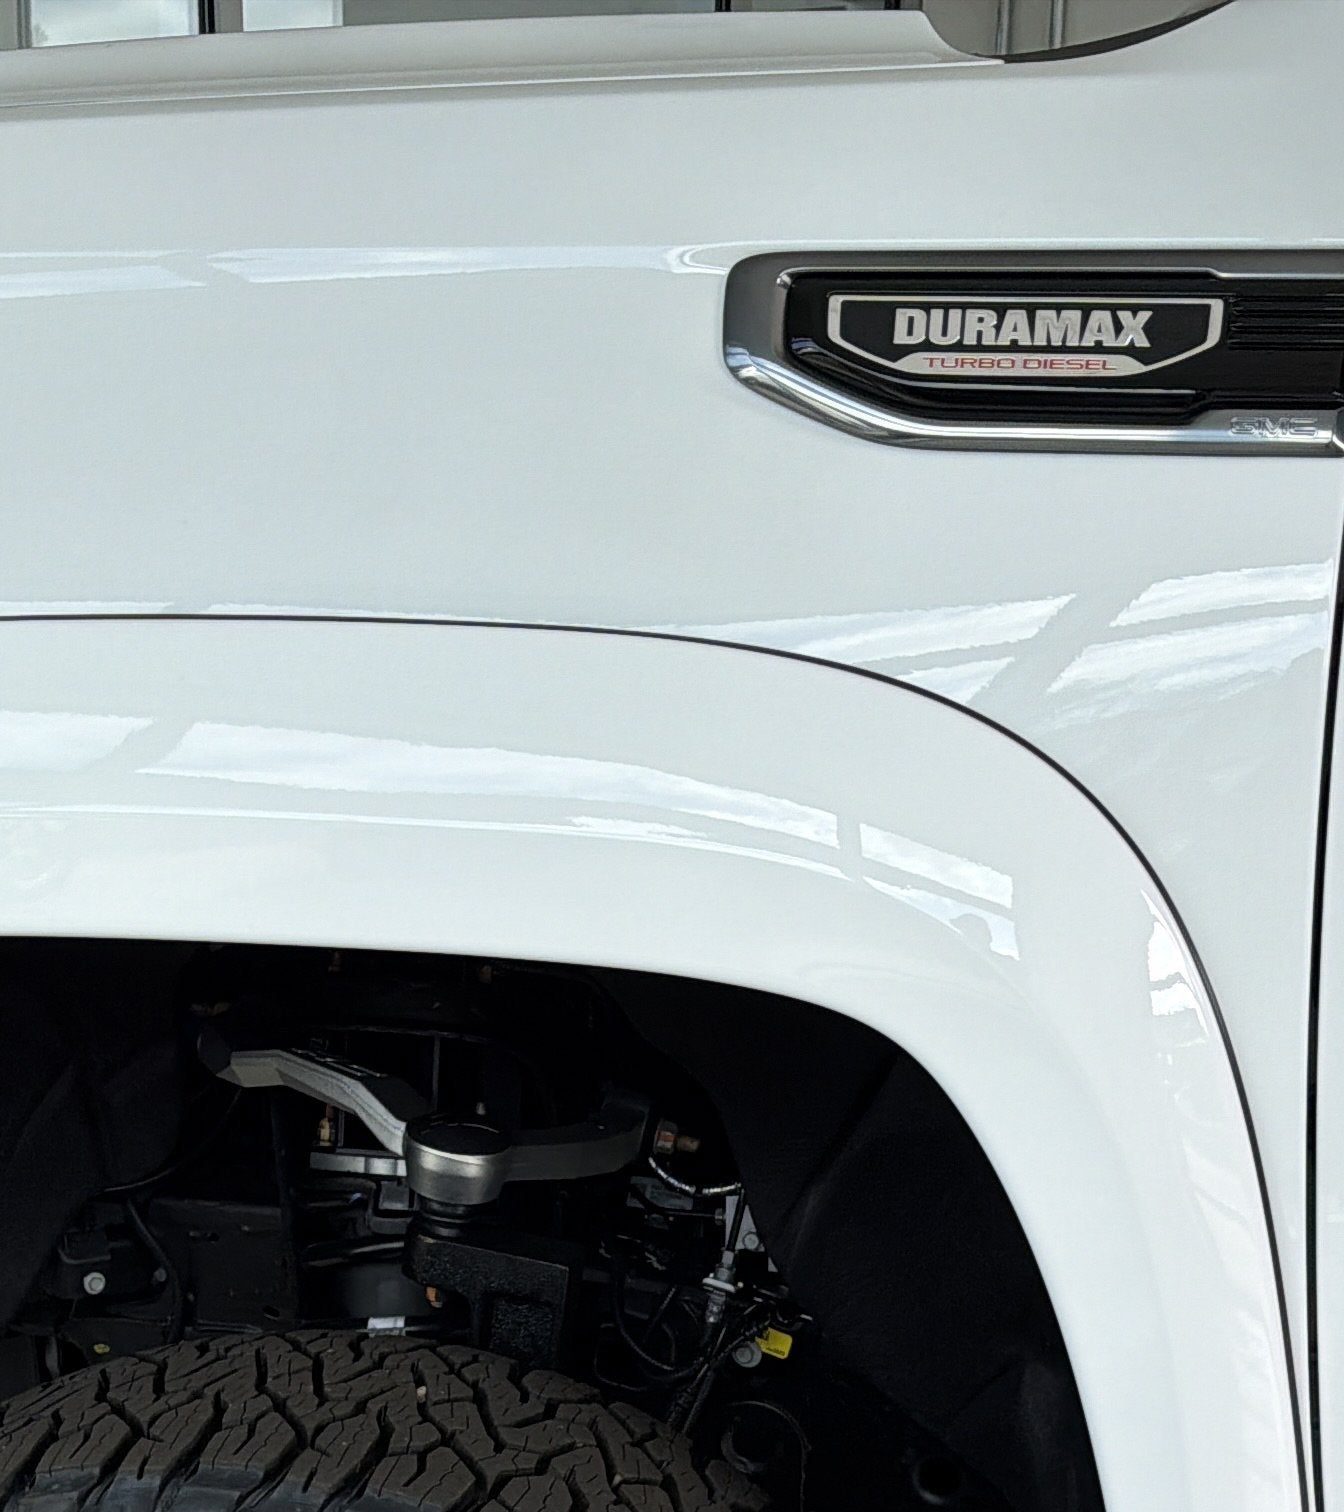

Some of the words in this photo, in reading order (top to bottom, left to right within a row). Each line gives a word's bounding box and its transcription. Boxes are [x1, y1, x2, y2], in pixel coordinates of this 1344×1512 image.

[892, 306, 1154, 348] DURAMAX
[922, 355, 1016, 370] TURBO
[1022, 357, 1118, 371] DIESEL
[1228, 414, 1318, 439] GMC
